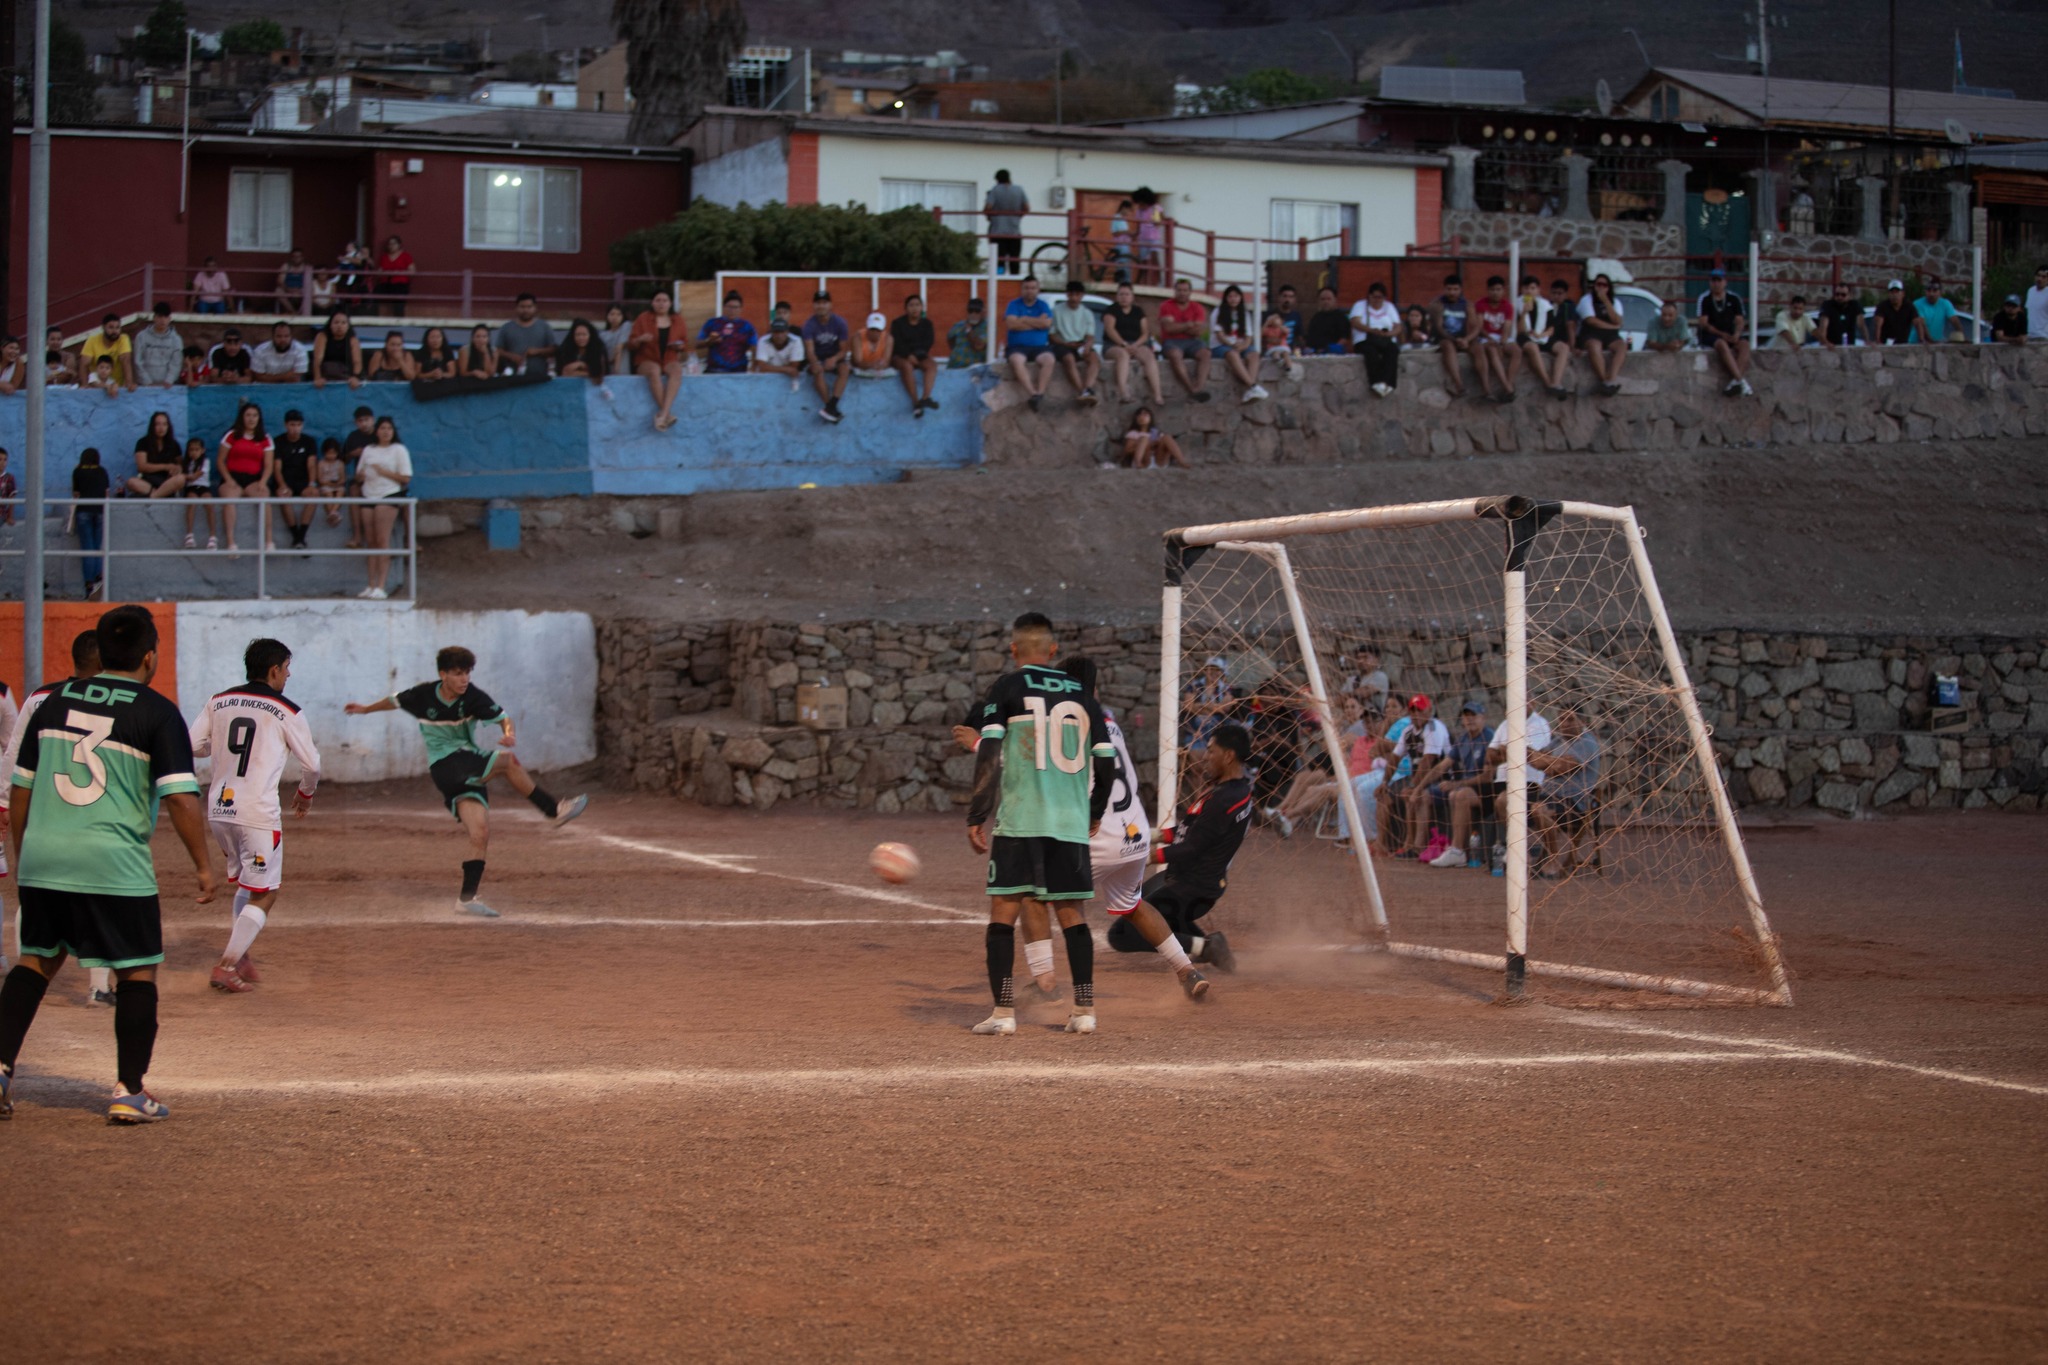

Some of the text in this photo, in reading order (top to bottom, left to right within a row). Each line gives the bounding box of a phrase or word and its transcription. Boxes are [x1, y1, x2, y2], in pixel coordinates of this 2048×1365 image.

[61, 681, 138, 707] LDF
[1024, 674, 1083, 693] LDF
[213, 698, 286, 722] COLLAO INVERSIONES
[228, 717, 257, 777] 9
[1023, 696, 1090, 774] 10
[53, 708, 116, 807] 3
